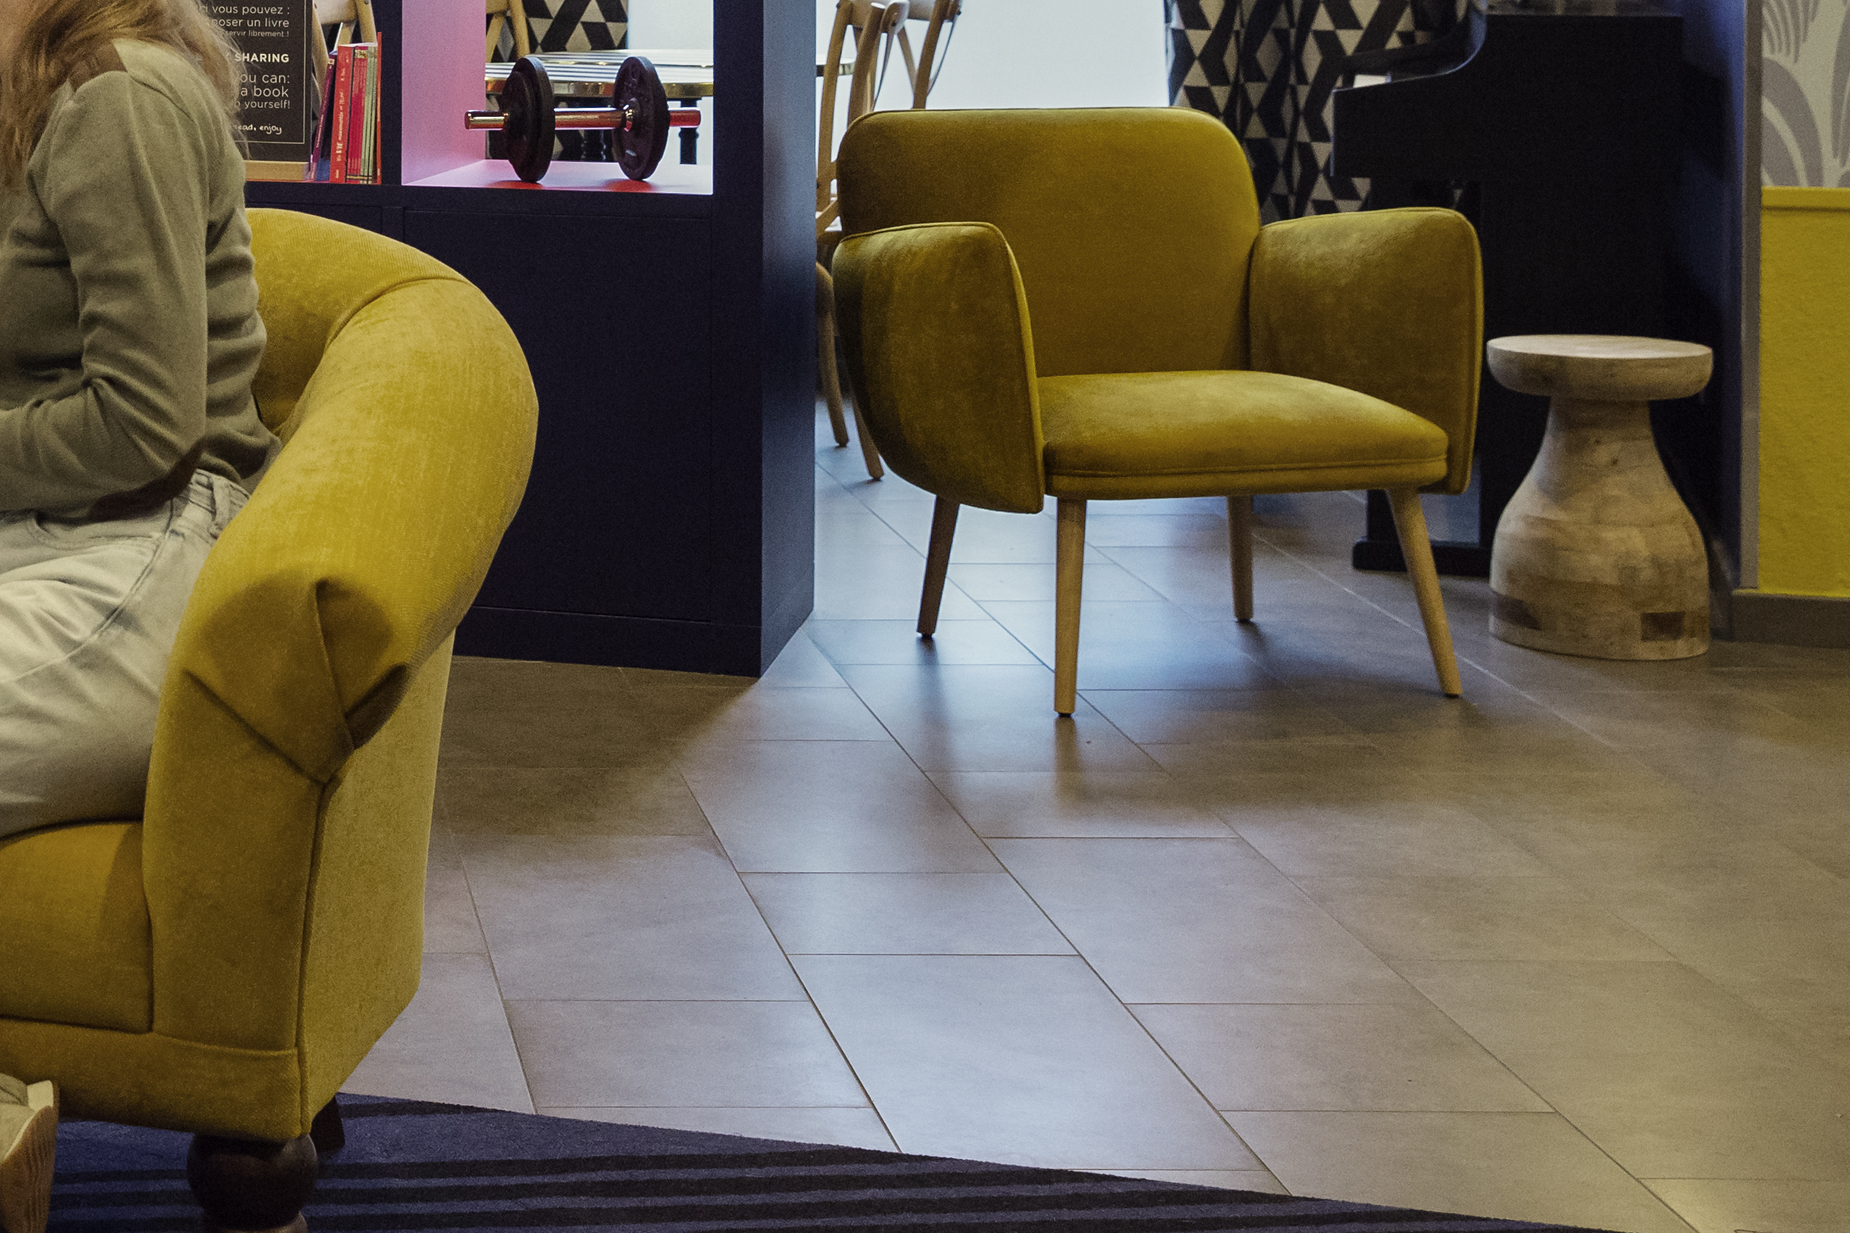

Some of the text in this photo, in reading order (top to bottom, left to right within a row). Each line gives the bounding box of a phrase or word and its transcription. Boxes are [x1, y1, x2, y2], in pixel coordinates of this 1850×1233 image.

[212, 6, 239, 14] vous
[242, 6, 284, 16] pouvez
[212, 19, 243, 27] poser
[264, 17, 290, 28] livre
[248, 29, 285, 38] librement
[234, 53, 290, 63] SHARING
[240, 74, 290, 84] ou can:
[240, 85, 289, 97] a book
[244, 99, 290, 110] yourself!
[259, 124, 283, 135] enjoy
